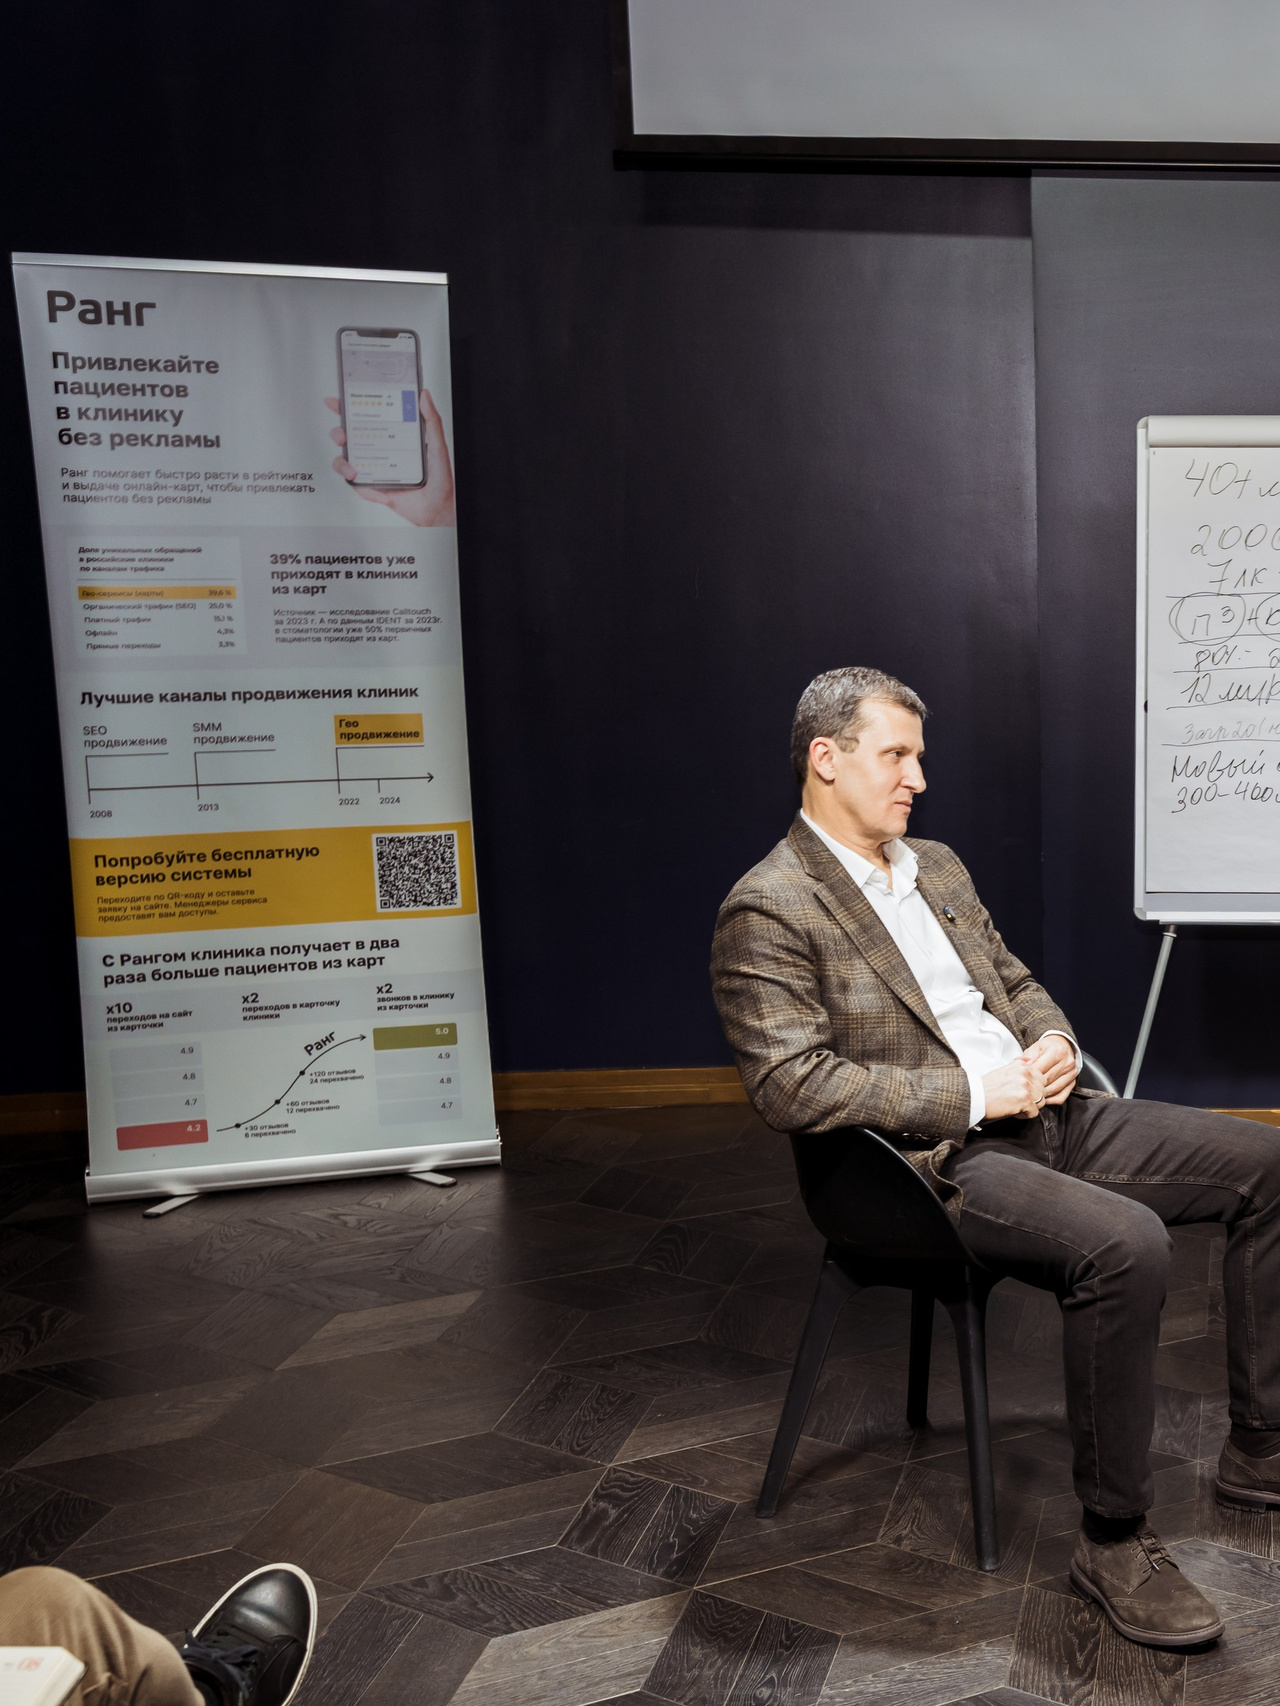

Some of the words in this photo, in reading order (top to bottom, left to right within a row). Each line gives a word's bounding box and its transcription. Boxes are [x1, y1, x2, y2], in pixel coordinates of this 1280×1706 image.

[47, 290, 156, 326] Ранг
[52, 351, 220, 374] Привлекайте
[54, 381, 189, 398] пациентов
[56, 406, 70, 420] в
[78, 407, 184, 427] клинику
[58, 428, 102, 446] без
[110, 432, 221, 451] рекламы
[61, 468, 89, 478] Ранг
[92, 470, 152, 480] помогает
[156, 469, 201, 482] быстро
[204, 472, 239, 482] расти
[242, 472, 250, 480] в
[253, 471, 313, 483] рейтингах
[62, 482, 70, 490] и
[73, 482, 120, 492] выдаче
[123, 481, 203, 495] онлайн-карт,
[206, 481, 243, 493] чтобы
[247, 484, 315, 494] привлекать
[63, 494, 129, 505] пациентов
[132, 493, 154, 503] без
[156, 495, 212, 506] рекламы
[270, 554, 301, 565] 39%
[304, 554, 382, 567] пациентов
[386, 554, 416, 568] уже
[271, 570, 341, 582] приходят
[345, 570, 354, 579] в
[357, 570, 418, 580] клиники
[272, 585, 290, 595] из
[294, 585, 327, 597] карт
[274, 608, 316, 617] Источник
[329, 608, 390, 617] исследование
[392, 608, 432, 616] Calltouch
[286, 618, 309, 626] 2023
[340, 618, 374, 627] данным
[376, 617, 402, 625] IDENT
[282, 626, 344, 635] стоматологии
[346, 626, 363, 636] уже
[364, 626, 383, 634] 50%
[276, 636, 322, 644] пациентов
[324, 635, 364, 644] приходят
[378, 635, 400, 644] карт.
[80, 691, 155, 708] Лучшие
[159, 690, 227, 704] каналы
[232, 688, 353, 705] продвижения
[357, 687, 419, 699] клиник
[192, 722, 223, 733] SMM
[339, 718, 360, 729] Гео
[83, 725, 108, 736] SEO
[340, 730, 420, 741] продвижение
[84, 736, 168, 750] продвижение
[194, 734, 275, 746] продвижение
[338, 798, 361, 806] 2022
[380, 796, 401, 805] 2024
[198, 804, 220, 812] 2013
[90, 810, 113, 819] 2008
[94, 850, 207, 870] Попробуйте
[211, 846, 320, 863] бесплатную
[96, 870, 166, 888] версию
[170, 867, 252, 883] системы
[97, 894, 151, 905] Переходите
[154, 894, 165, 902] по
[167, 890, 205, 903] QR-коду
[216, 888, 255, 897] оставьте
[98, 904, 128, 915] заявку
[130, 904, 141, 912] на
[174, 898, 229, 910] Менеджеры
[232, 896, 268, 906] сервиса
[98, 911, 156, 923] предоставят
[158, 910, 176, 918] вам
[102, 954, 115, 968] С
[120, 952, 186, 967] Рангом
[191, 946, 266, 962] клиника
[270, 940, 351, 957] получает
[355, 940, 365, 950] в
[370, 938, 400, 952] два
[104, 972, 147, 988] раза
[152, 966, 220, 982] больше
[224, 960, 318, 977] пациентов
[322, 958, 343, 969] из
[347, 955, 386, 970] карт
[420, 992, 455, 1002] клинику
[242, 1003, 291, 1014] переходов
[300, 999, 340, 1010] карточку
[389, 1002, 429, 1012] карточки
[107, 1014, 158, 1025] переходов
[159, 1012, 171, 1020] на
[172, 1010, 193, 1018] сайт
[242, 1012, 280, 1022] клиники
[108, 1025, 119, 1033] из
[120, 1022, 164, 1032] карточки
[304, 1031, 336, 1056] Ранг
[180, 1046, 194, 1055] 4.9
[438, 1052, 451, 1060] 4.9
[182, 1072, 196, 1081] 4.8
[440, 1077, 452, 1085] 4.8
[184, 1098, 198, 1107] 4.7
[186, 1124, 202, 1132] 4.2
